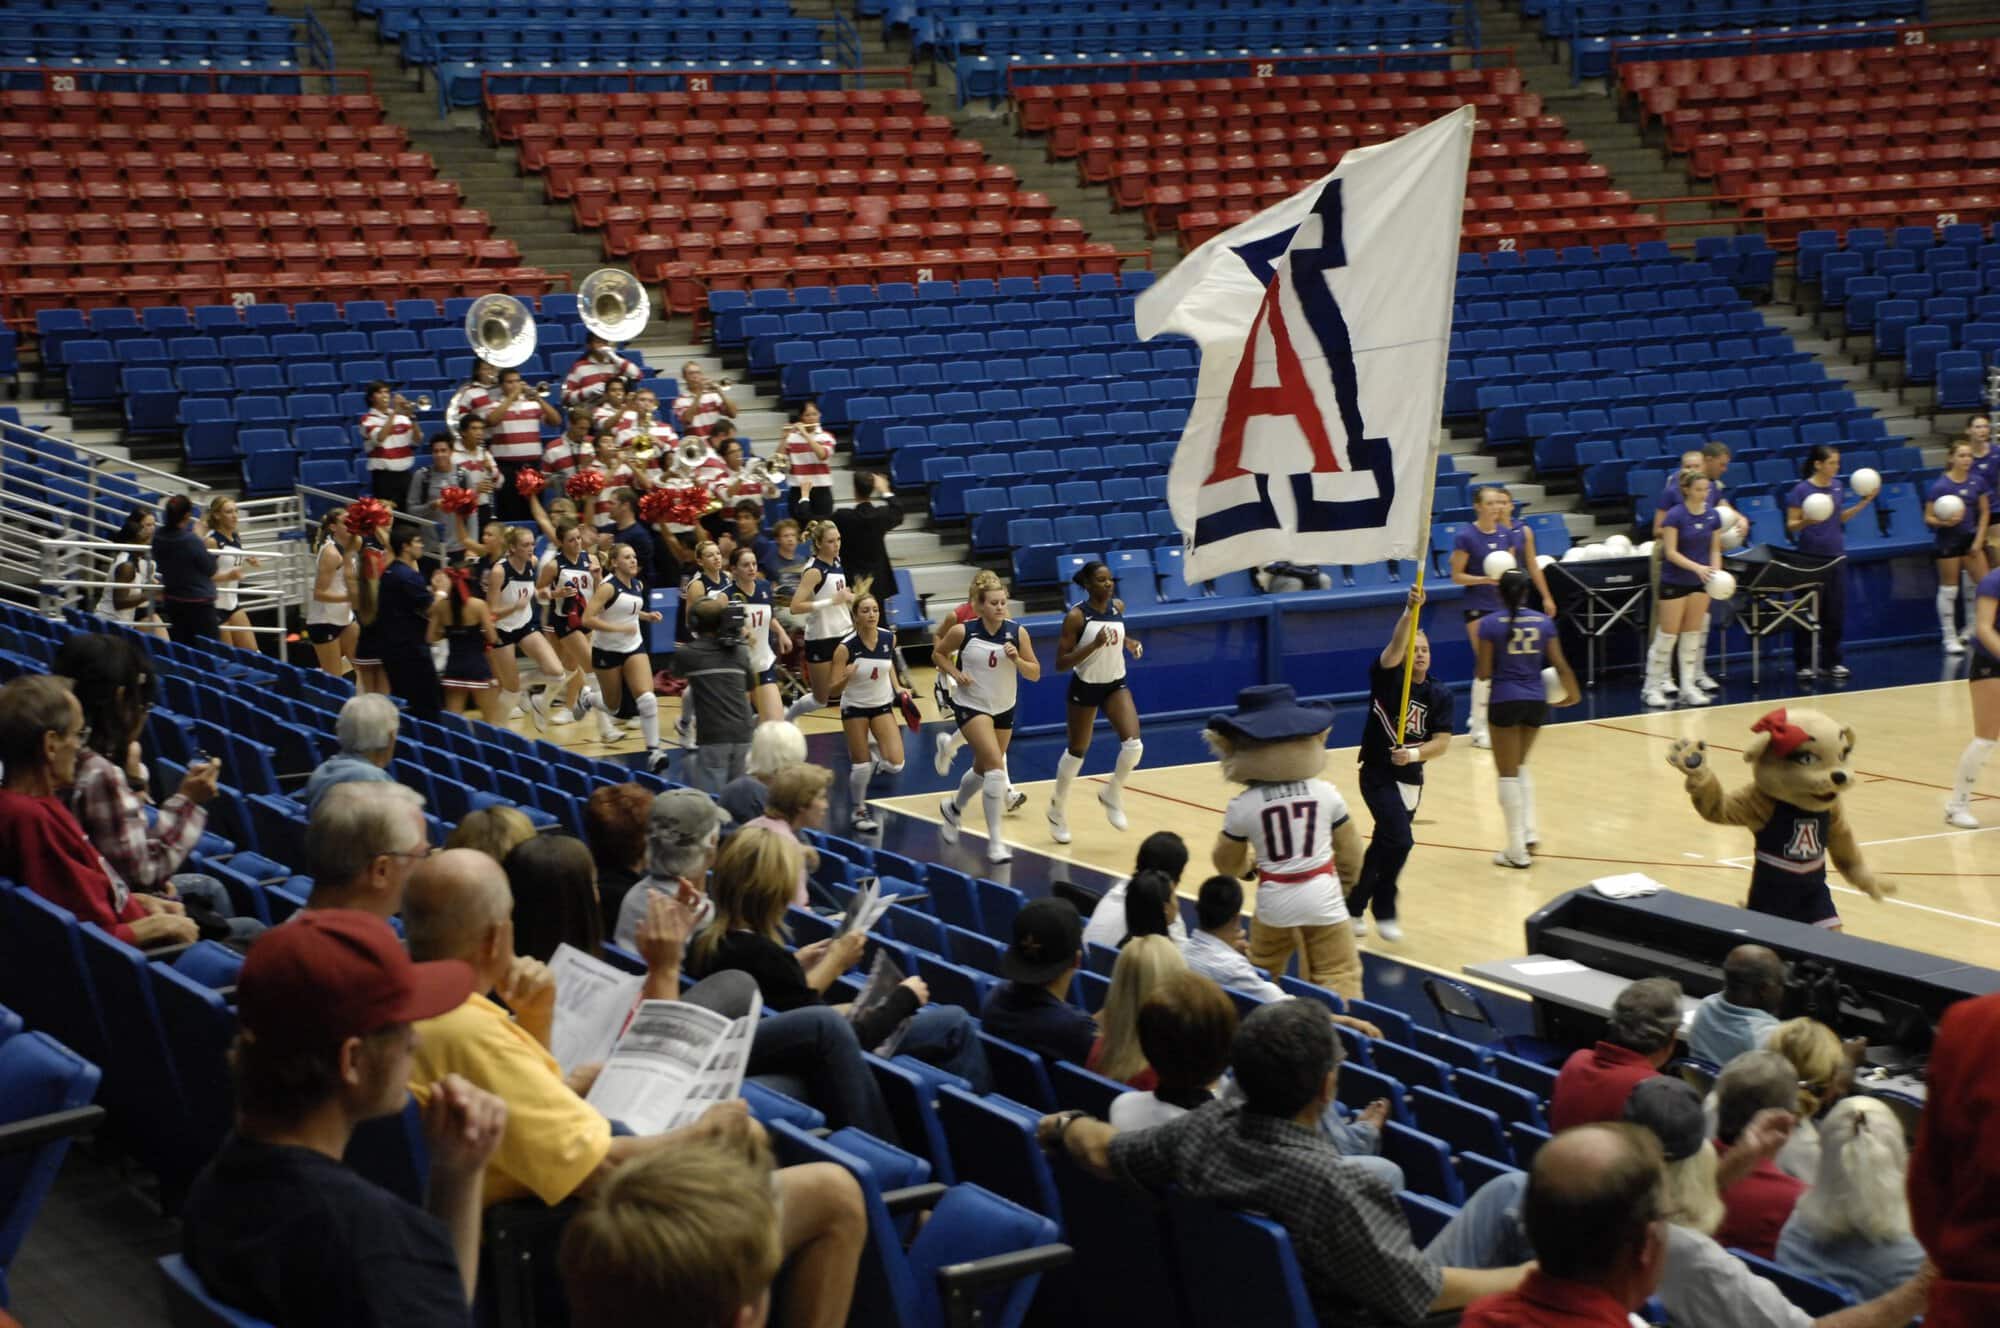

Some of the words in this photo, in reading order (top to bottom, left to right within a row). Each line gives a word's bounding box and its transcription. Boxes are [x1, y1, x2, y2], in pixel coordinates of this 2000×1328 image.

[1904, 31, 1924, 45] 23
[1257, 64, 1272, 77] 22
[53, 76, 75, 91] 20
[690, 78, 708, 91] 21
[1499, 238, 1516, 251] 22
[917, 268, 933, 283] 21
[232, 292, 256, 309] 20
[751, 609, 764, 629] 17
[1508, 627, 1540, 654] 22
[988, 650, 997, 669] 6
[870, 667, 879, 681] 4
[1261, 800, 1318, 862] 07
[1783, 818, 1824, 859] A
